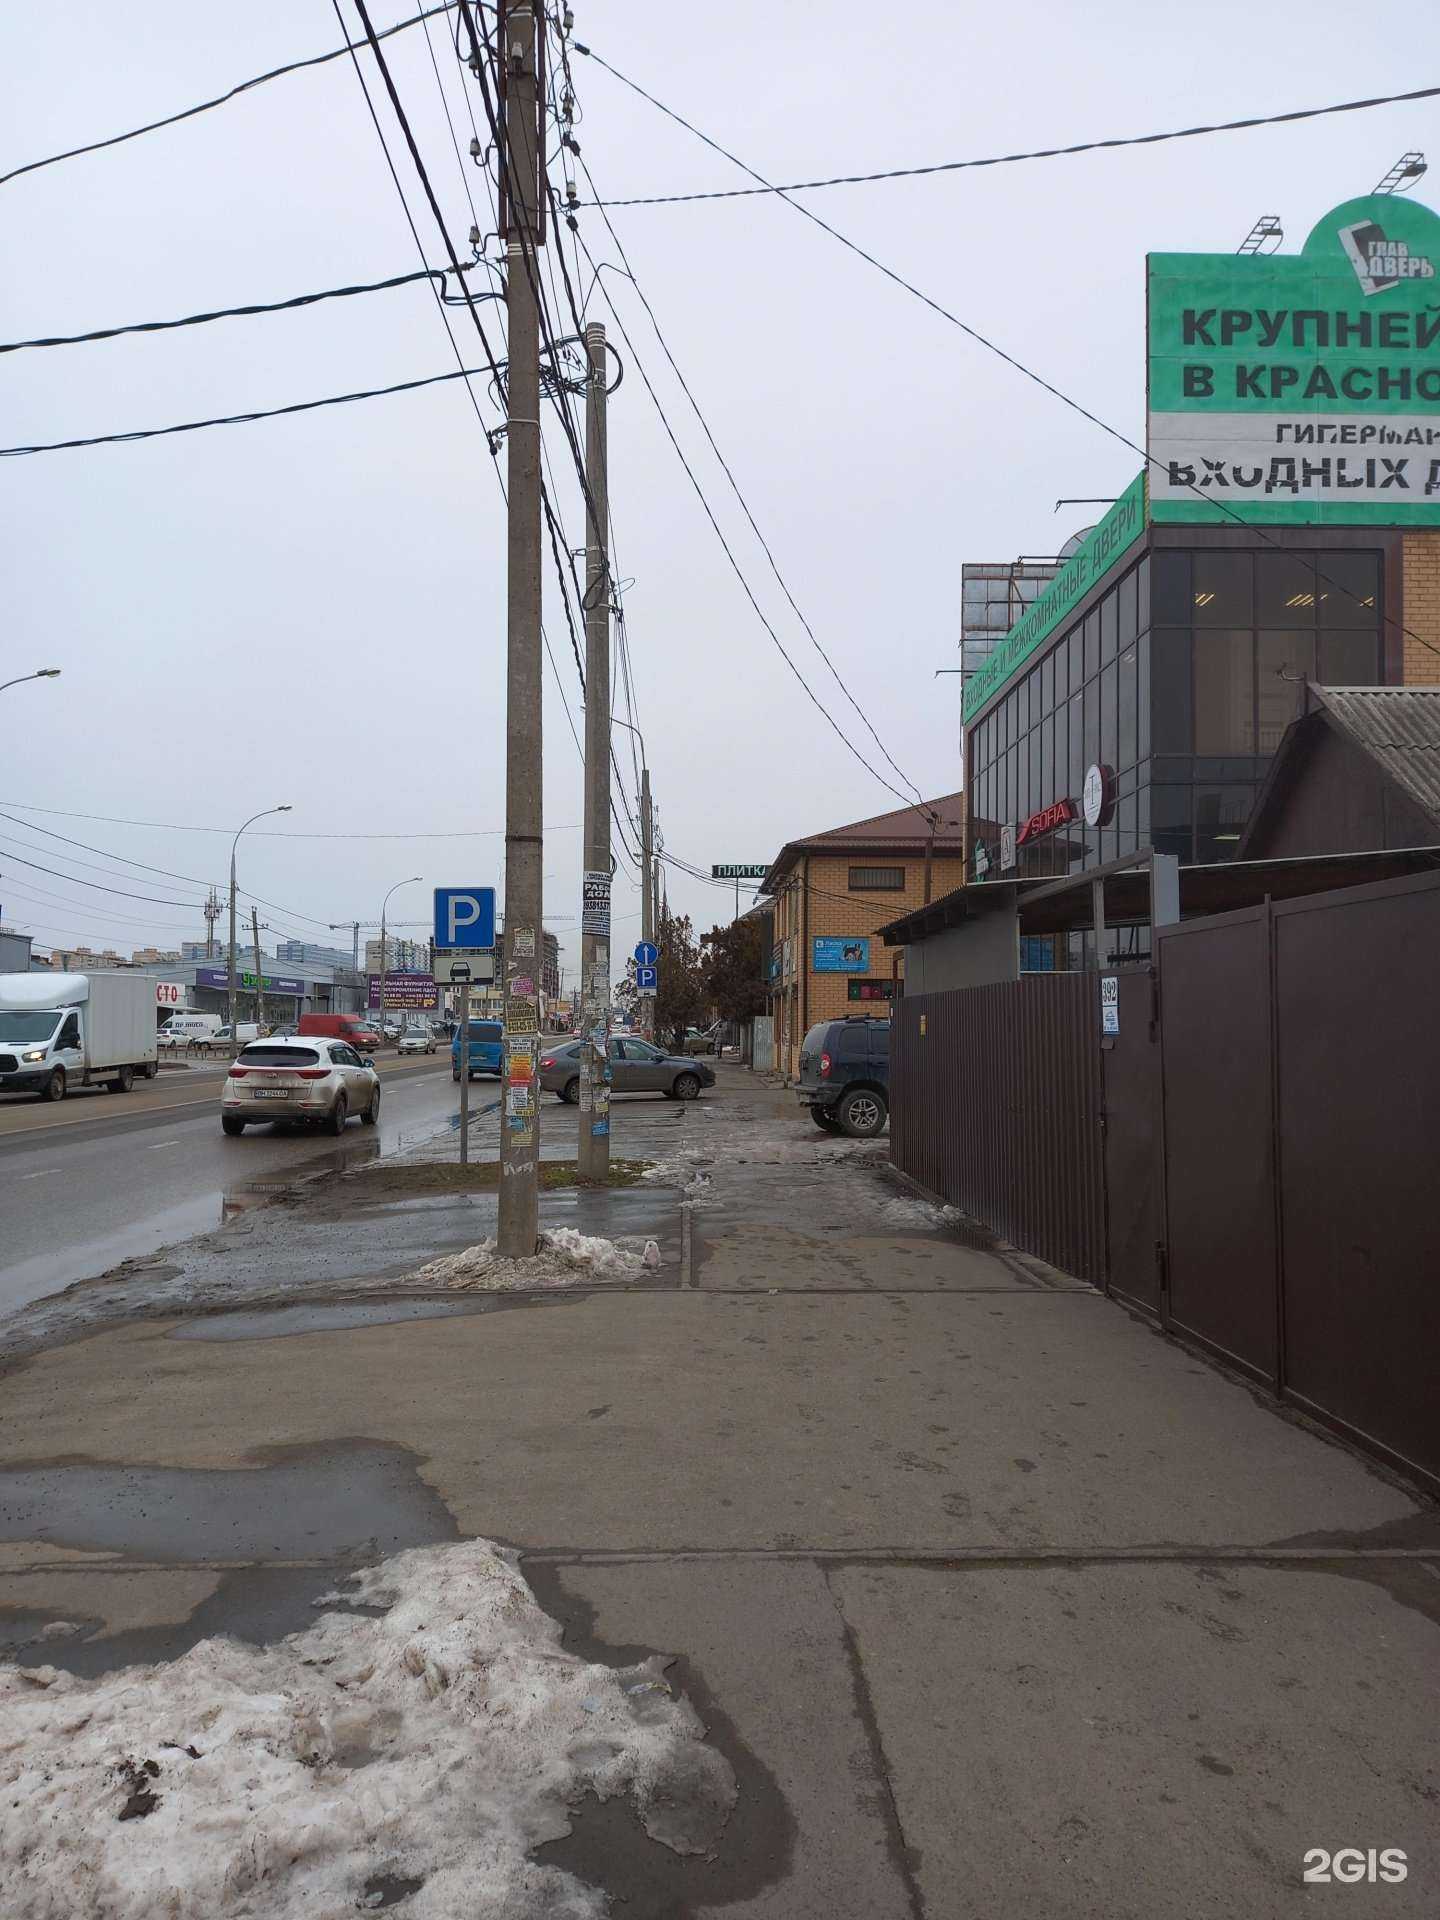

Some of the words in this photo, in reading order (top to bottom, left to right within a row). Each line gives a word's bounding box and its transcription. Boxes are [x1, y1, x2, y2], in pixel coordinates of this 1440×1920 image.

[1368, 240, 1409, 257] ГЛАВ
[1368, 256, 1435, 278] ДВЕРЬ
[1183, 364, 1215, 398] В
[1008, 560, 1088, 664] МЕЖКОМНАТНЫЕ
[1093, 495, 1136, 577] ДВЕРИ
[1031, 803, 1067, 835] SOFIA
[448, 895, 480, 942] P
[642, 969, 653, 985] P
[157, 985, 178, 1003] СТО
[1103, 982, 1117, 1002] 392
